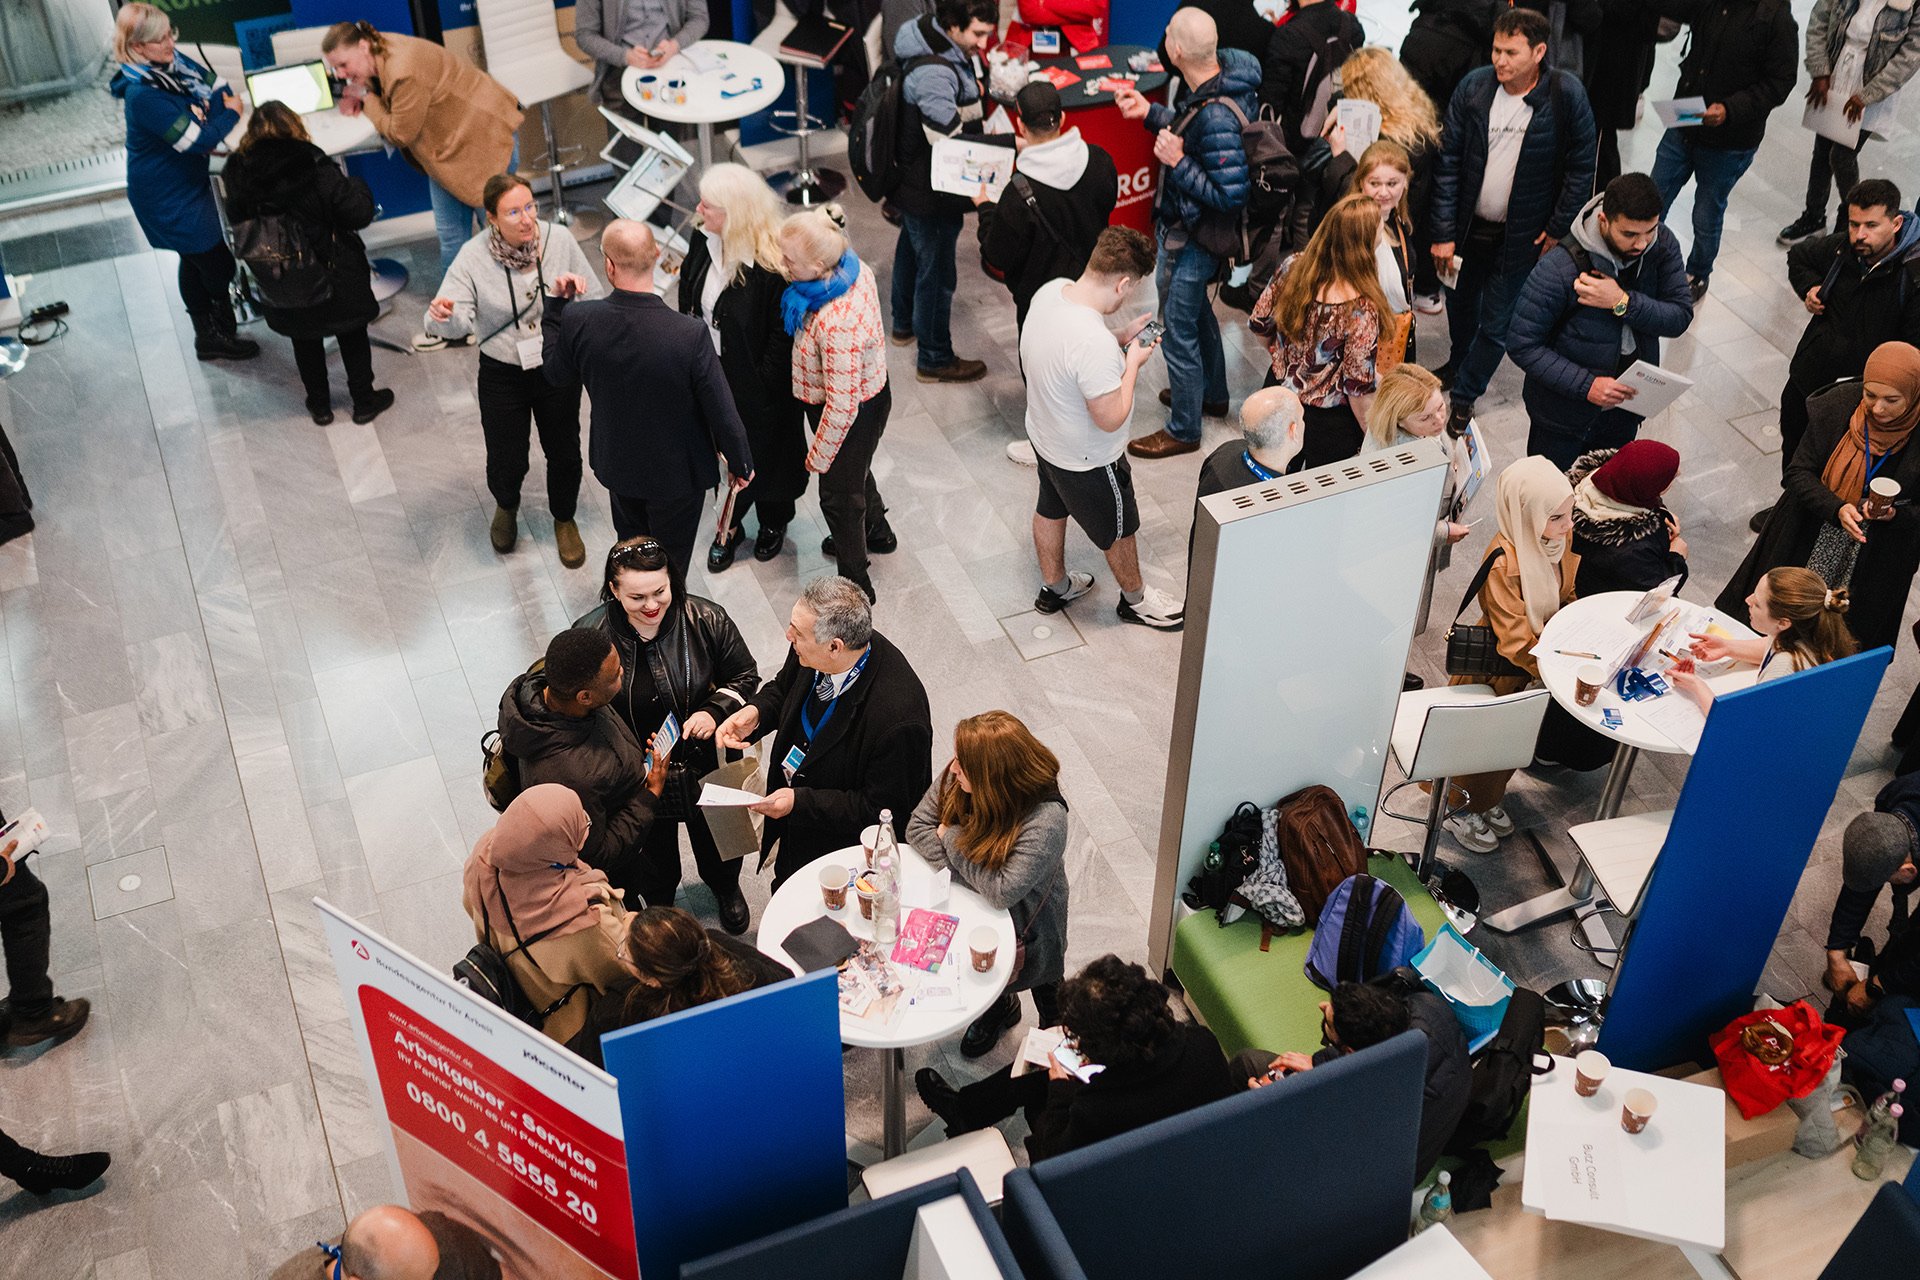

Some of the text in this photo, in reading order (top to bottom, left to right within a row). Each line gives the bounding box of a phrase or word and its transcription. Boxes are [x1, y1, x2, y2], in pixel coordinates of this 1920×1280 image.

[375, 957, 494, 1036] Bundesagentur für Arbeit
[394, 1030, 597, 1173] Arbeitgeber - Service
[522, 1048, 585, 1092] jobcenter
[397, 1049, 598, 1191] Ihr Partner wenn es um Personal geht!
[406, 1081, 598, 1225] 0800 4 5555 20
[1568, 1155, 1582, 1185] GmbH
[1582, 1143, 1600, 1200] Butz Consult
